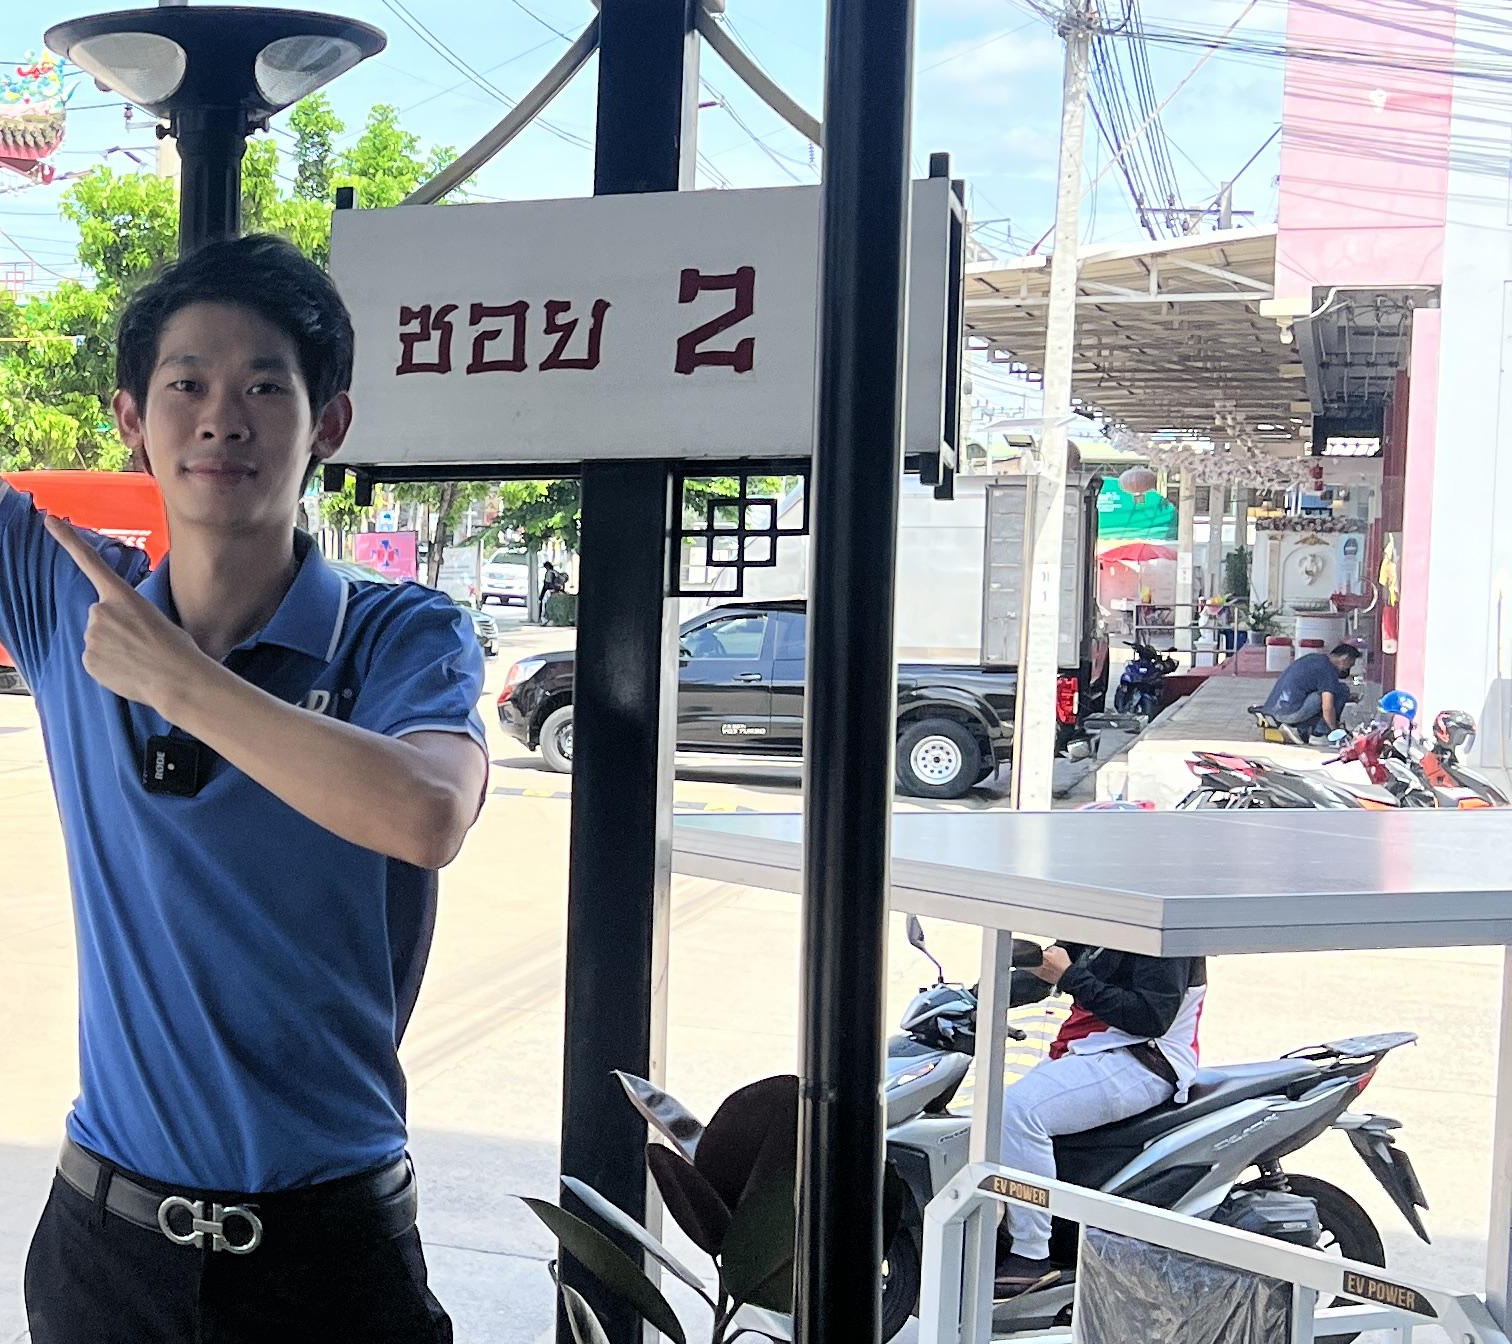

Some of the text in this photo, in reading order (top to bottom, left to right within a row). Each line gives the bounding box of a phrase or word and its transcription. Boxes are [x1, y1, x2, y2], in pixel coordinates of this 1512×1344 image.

[396, 266, 756, 376] ซอย 2
[993, 1177, 1047, 1206] EV POWER
[1347, 1274, 1416, 1310] EV POWER
